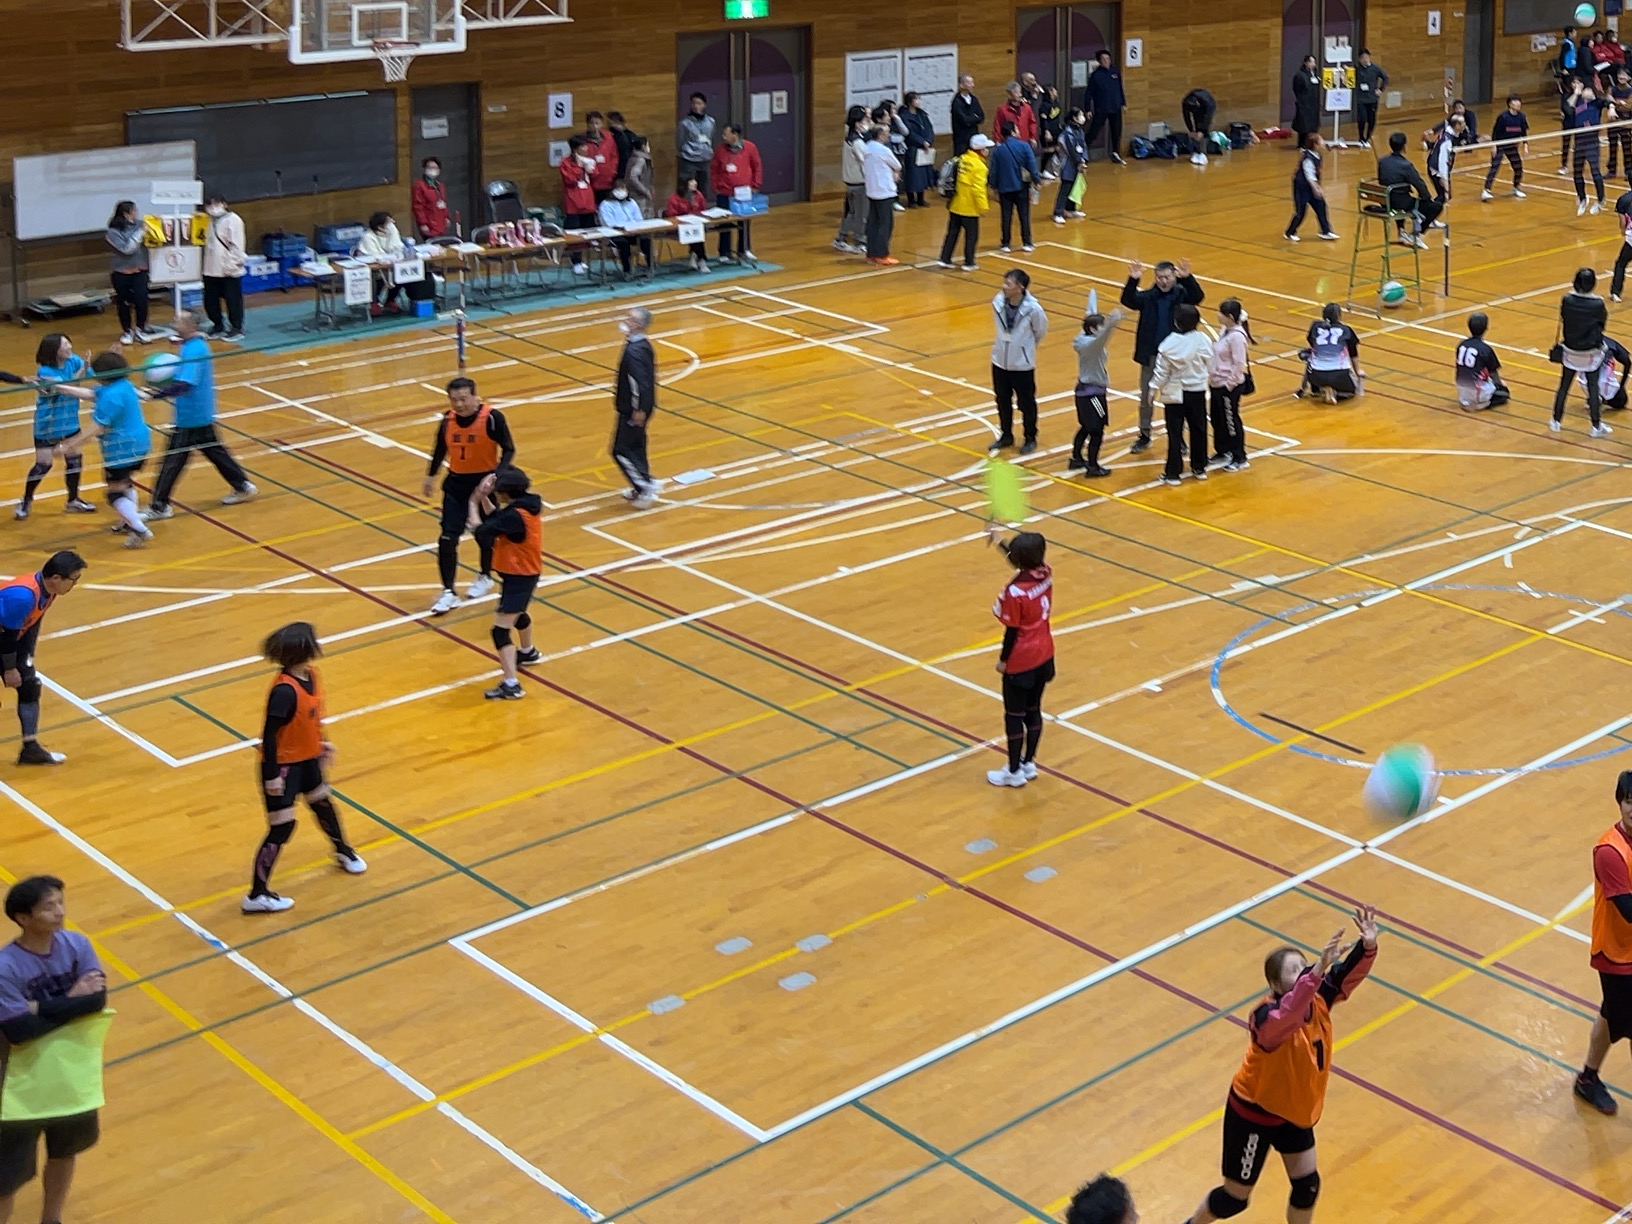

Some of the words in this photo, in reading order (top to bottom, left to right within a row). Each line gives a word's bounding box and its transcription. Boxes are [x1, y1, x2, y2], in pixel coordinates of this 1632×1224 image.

[1129, 45, 1138, 60] 6
[553, 101, 566, 119] 8
[1316, 327, 1344, 346] 27
[1458, 345, 1478, 368] 16
[1312, 1039, 1325, 1071] 1
[1240, 1133, 1260, 1180] adidas
